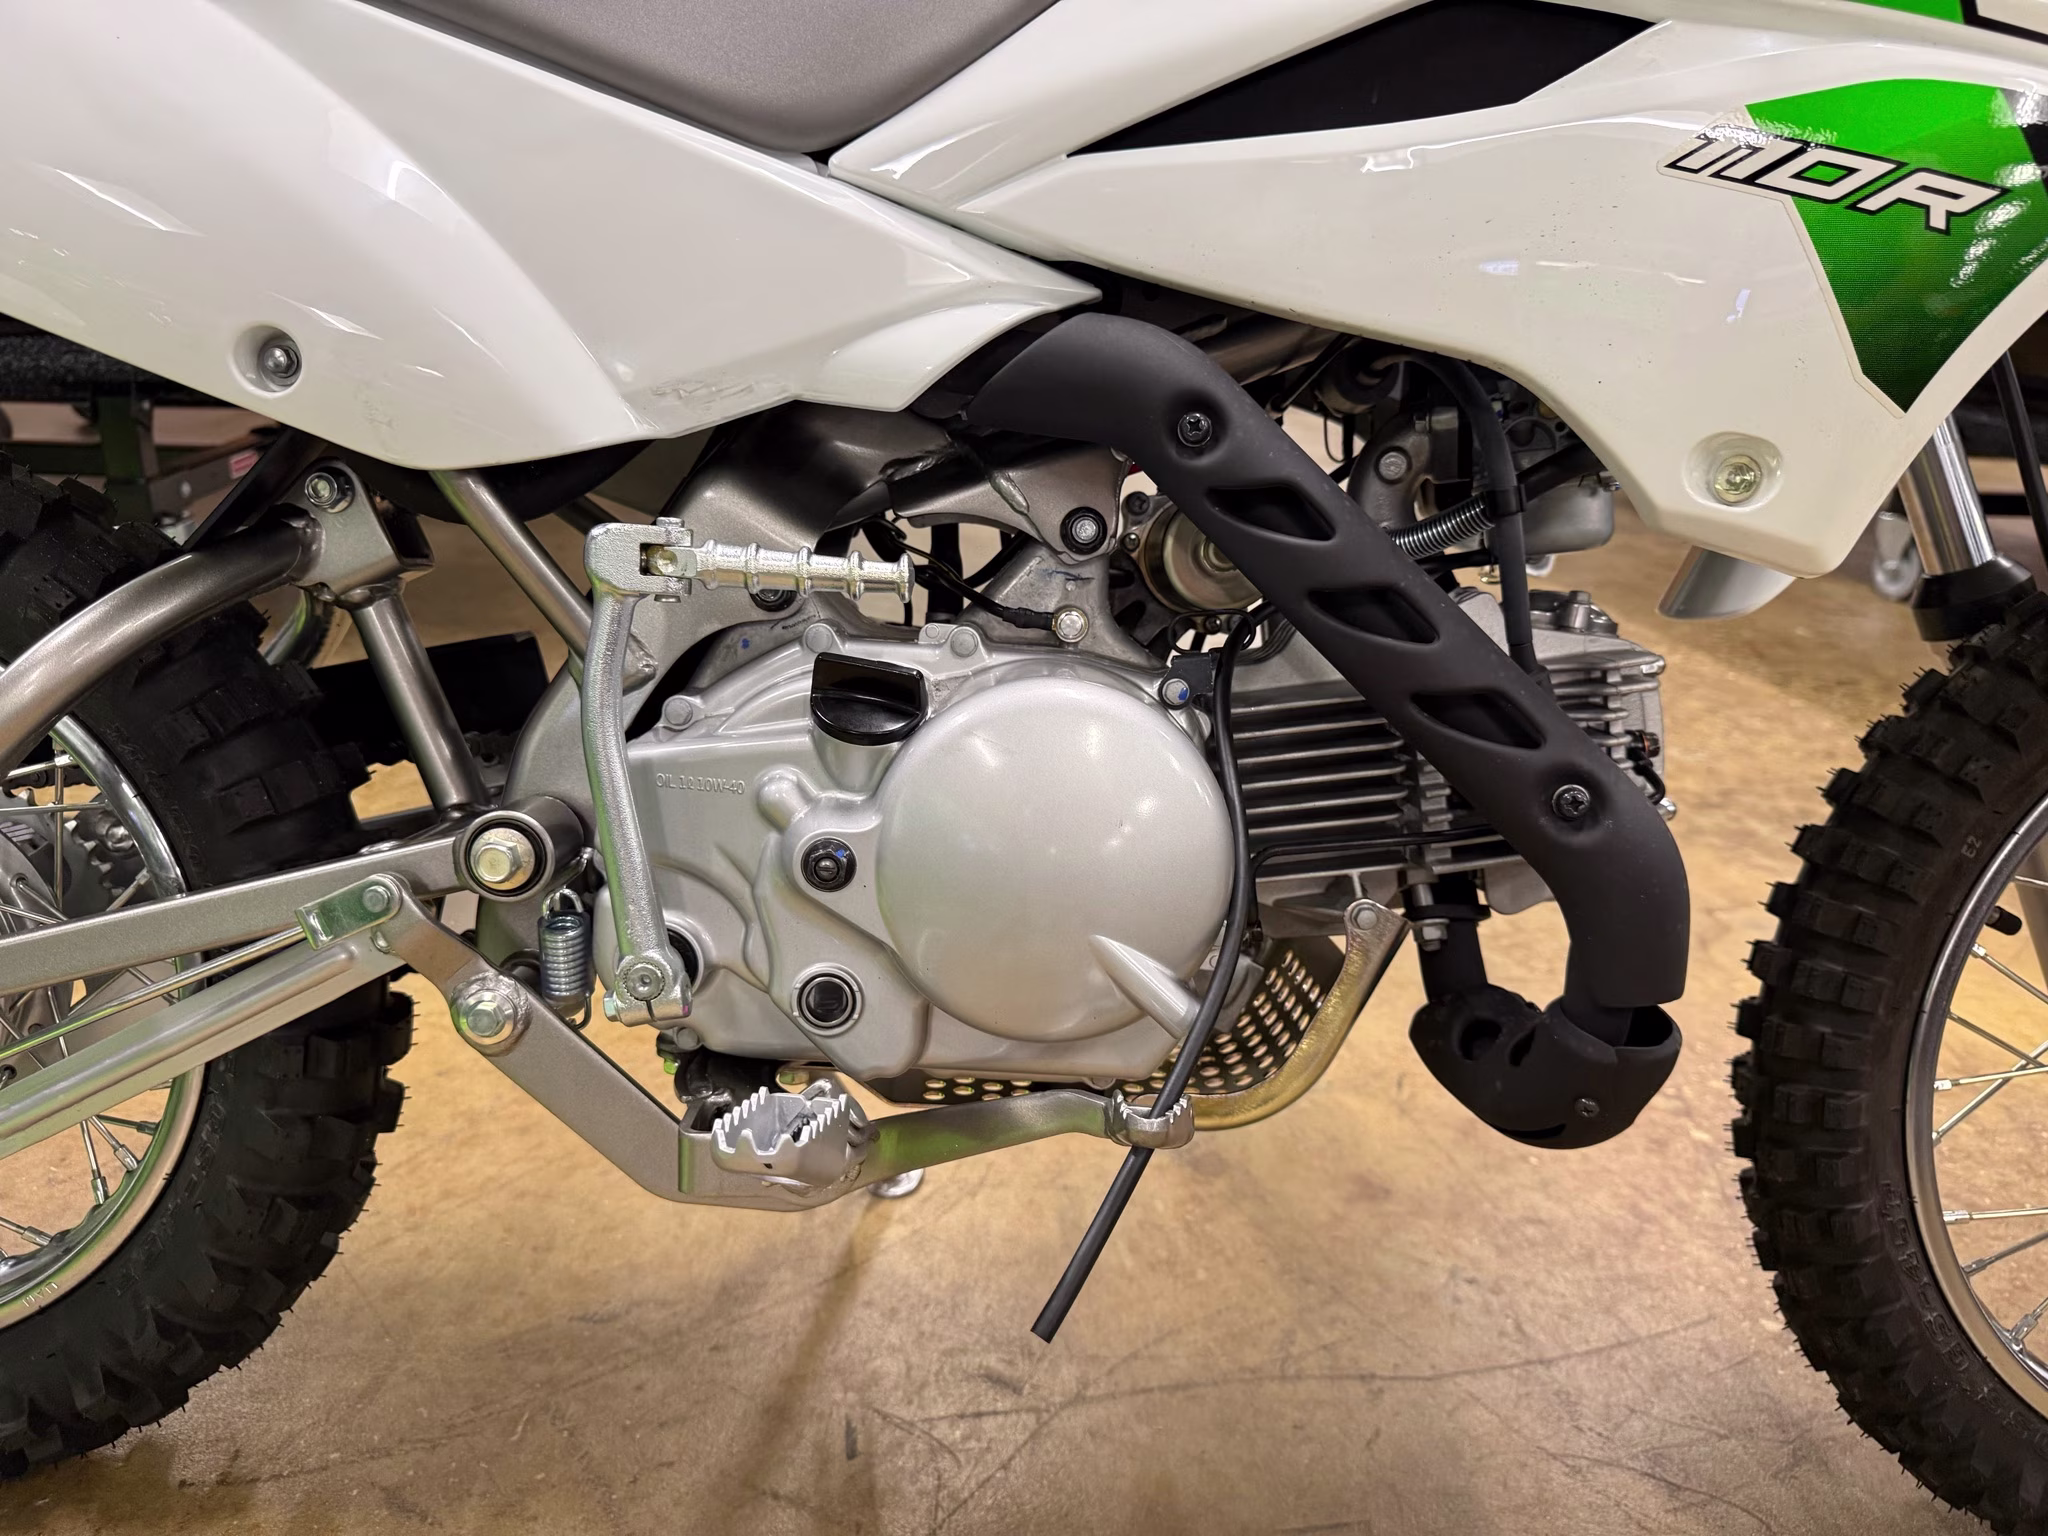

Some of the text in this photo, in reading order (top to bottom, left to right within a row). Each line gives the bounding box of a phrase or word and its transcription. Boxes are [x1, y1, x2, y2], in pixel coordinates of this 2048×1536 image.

[1664, 124, 2011, 235] 110R
[656, 773, 676, 788] OIL
[697, 777, 745, 794] 10W-40
